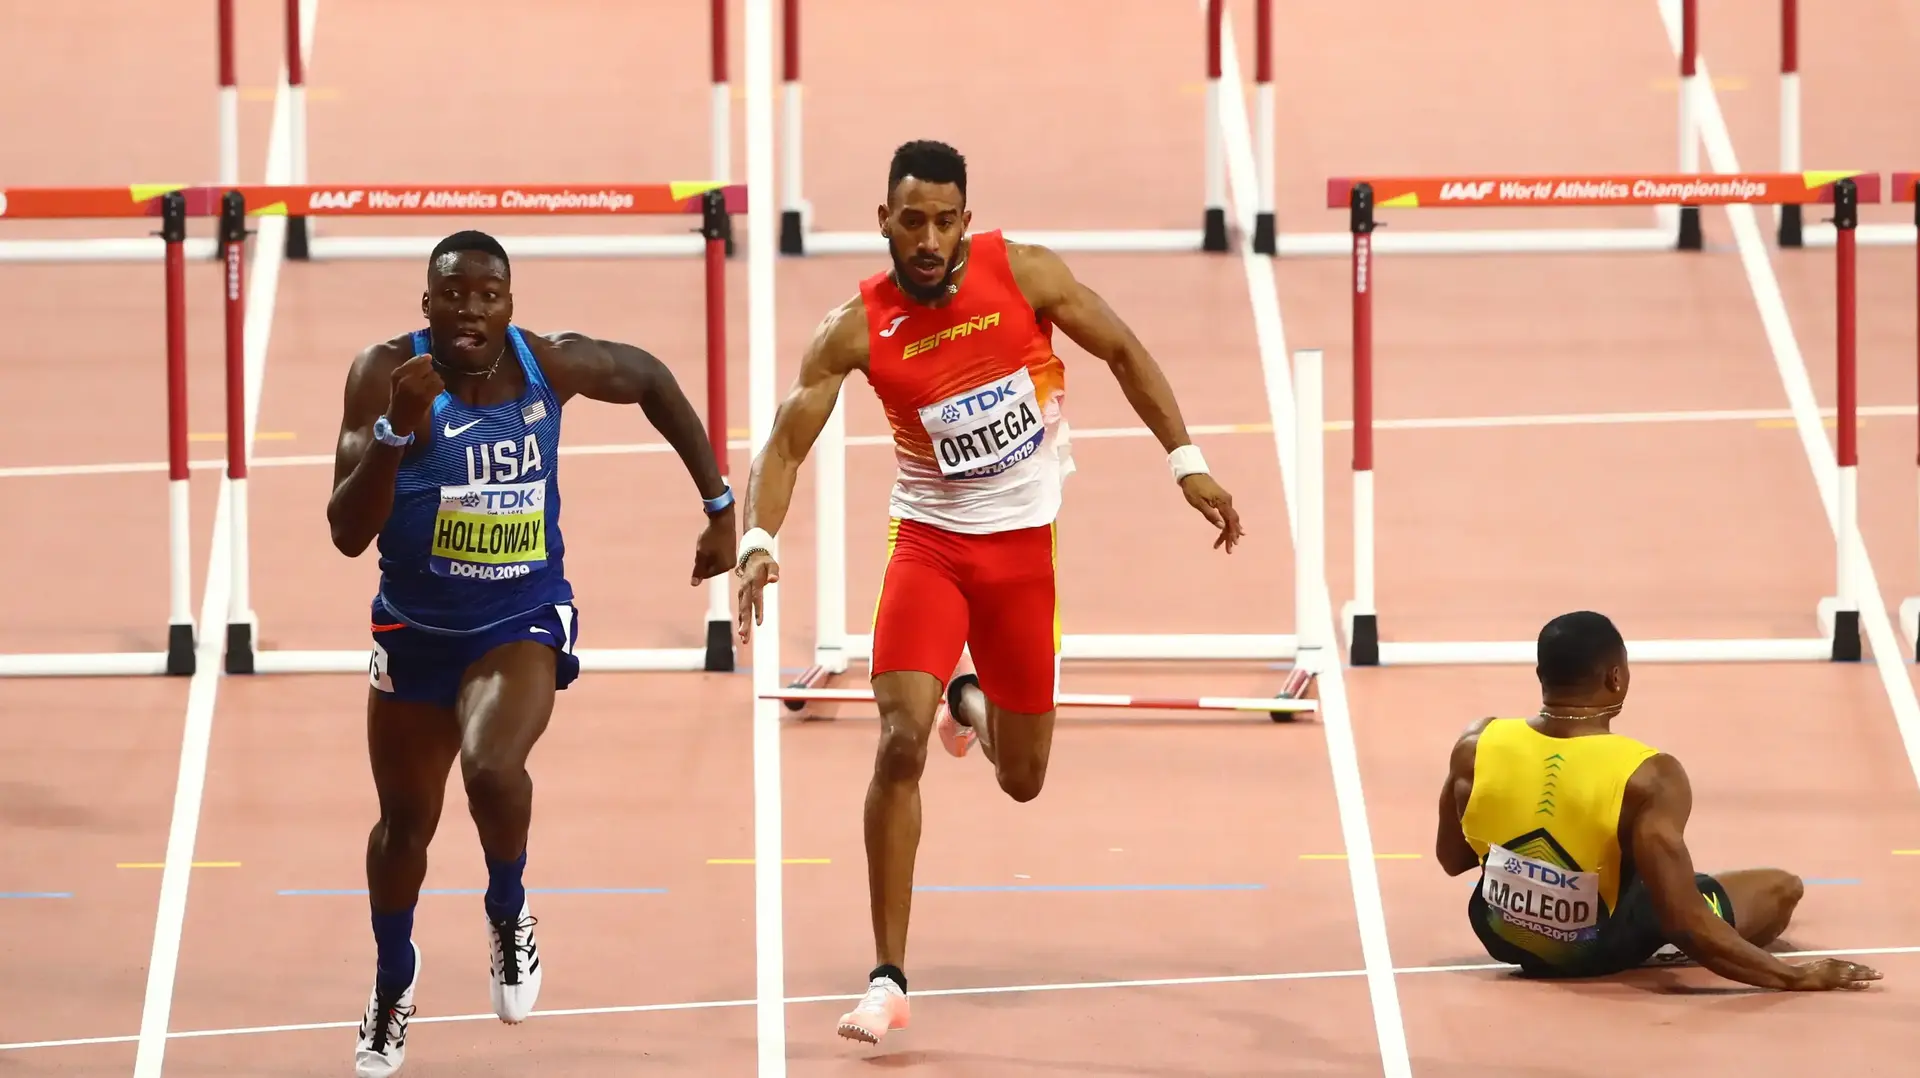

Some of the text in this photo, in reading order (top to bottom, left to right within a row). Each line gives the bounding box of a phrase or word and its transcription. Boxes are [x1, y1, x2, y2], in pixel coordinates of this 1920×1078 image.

[309, 189, 635, 212] IAAF World Athletics Championships
[1440, 178, 1767, 201] IAAF World Athletics Championships
[902, 312, 1000, 361] ESPAÑA
[956, 380, 1017, 416] TDK
[939, 401, 1037, 467] ORTEGA
[465, 433, 542, 485] USA
[480, 488, 536, 510] TDK
[437, 519, 541, 554] HOLLOWAY
[449, 561, 531, 580] DOHA2019
[1522, 861, 1581, 891] TDK
[1488, 879, 1590, 924] McLEOD
[1503, 911, 1579, 942] DOHA2019
